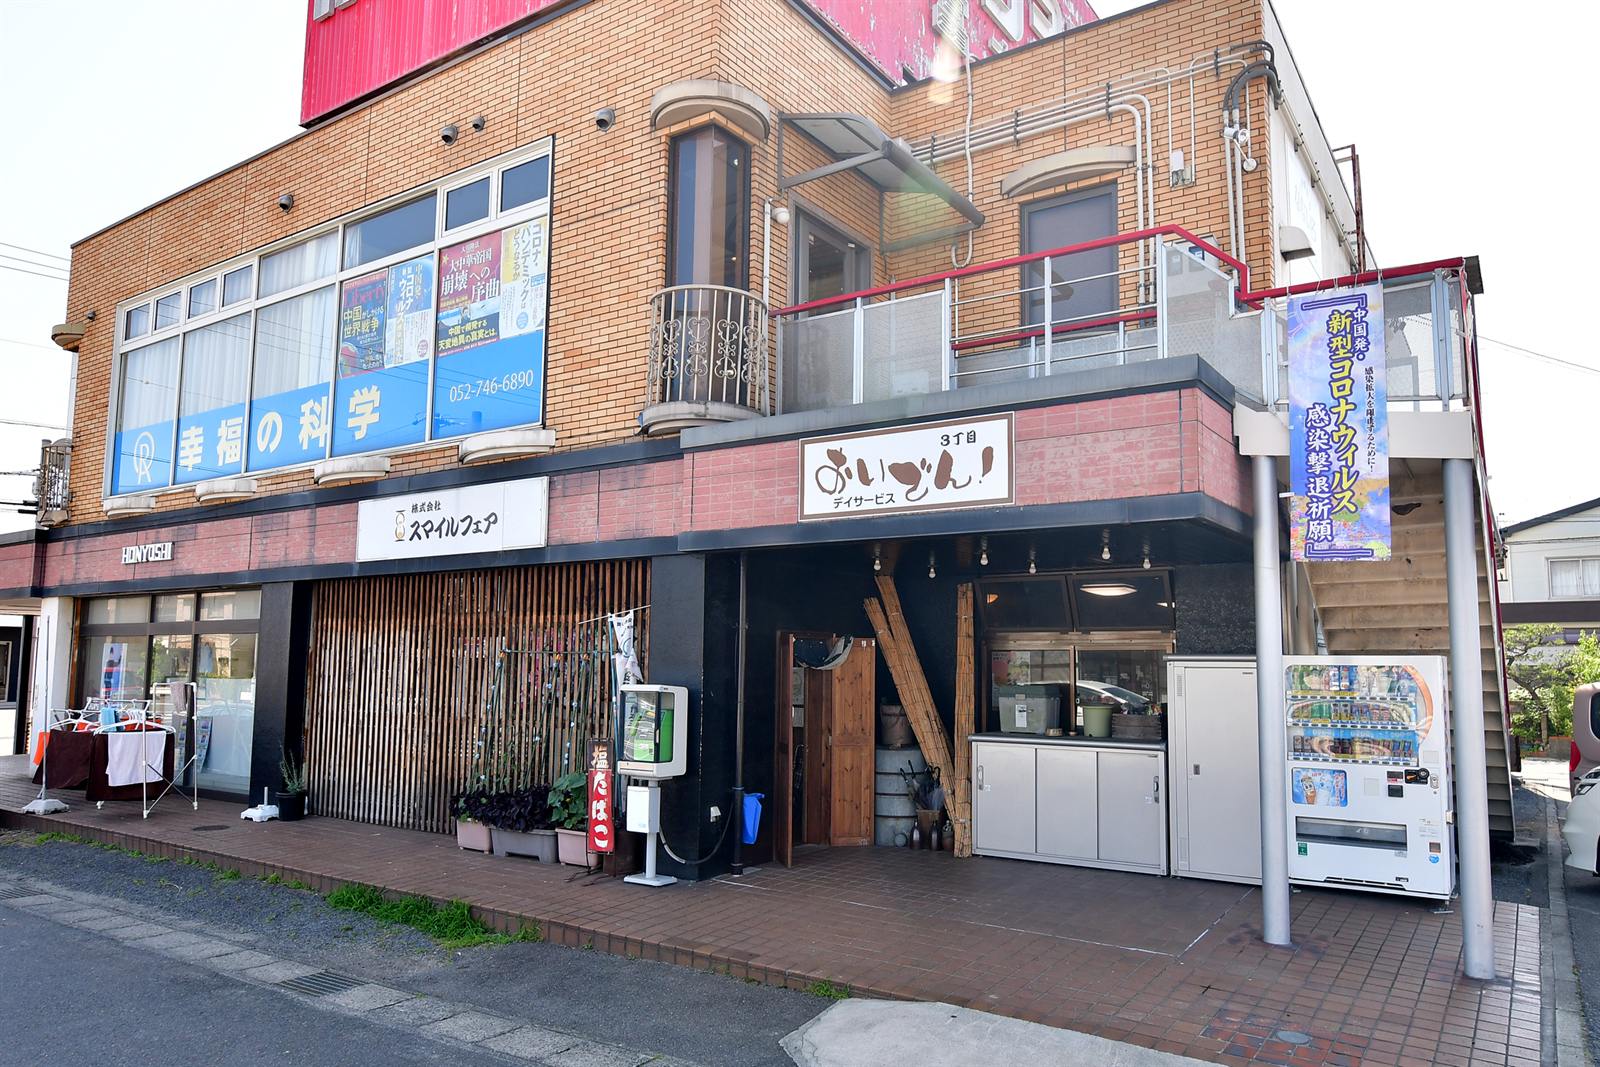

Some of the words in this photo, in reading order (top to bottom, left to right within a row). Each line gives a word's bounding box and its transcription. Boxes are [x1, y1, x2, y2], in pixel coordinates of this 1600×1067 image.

[449, 369, 534, 402] 052-746-6890
[1328, 310, 1359, 514] 新型コロナウィルス
[178, 384, 381, 472] 幸福の科学
[940, 430, 976, 447] 3丁目
[1306, 403, 1334, 542] 感染撃退祈願
[411, 500, 441, 513] 株式会社
[833, 493, 896, 509] デイサービス
[409, 512, 498, 541] スマイルフェア
[122, 543, 172, 564] HONYOSHI
[592, 771, 609, 848] たばこ
